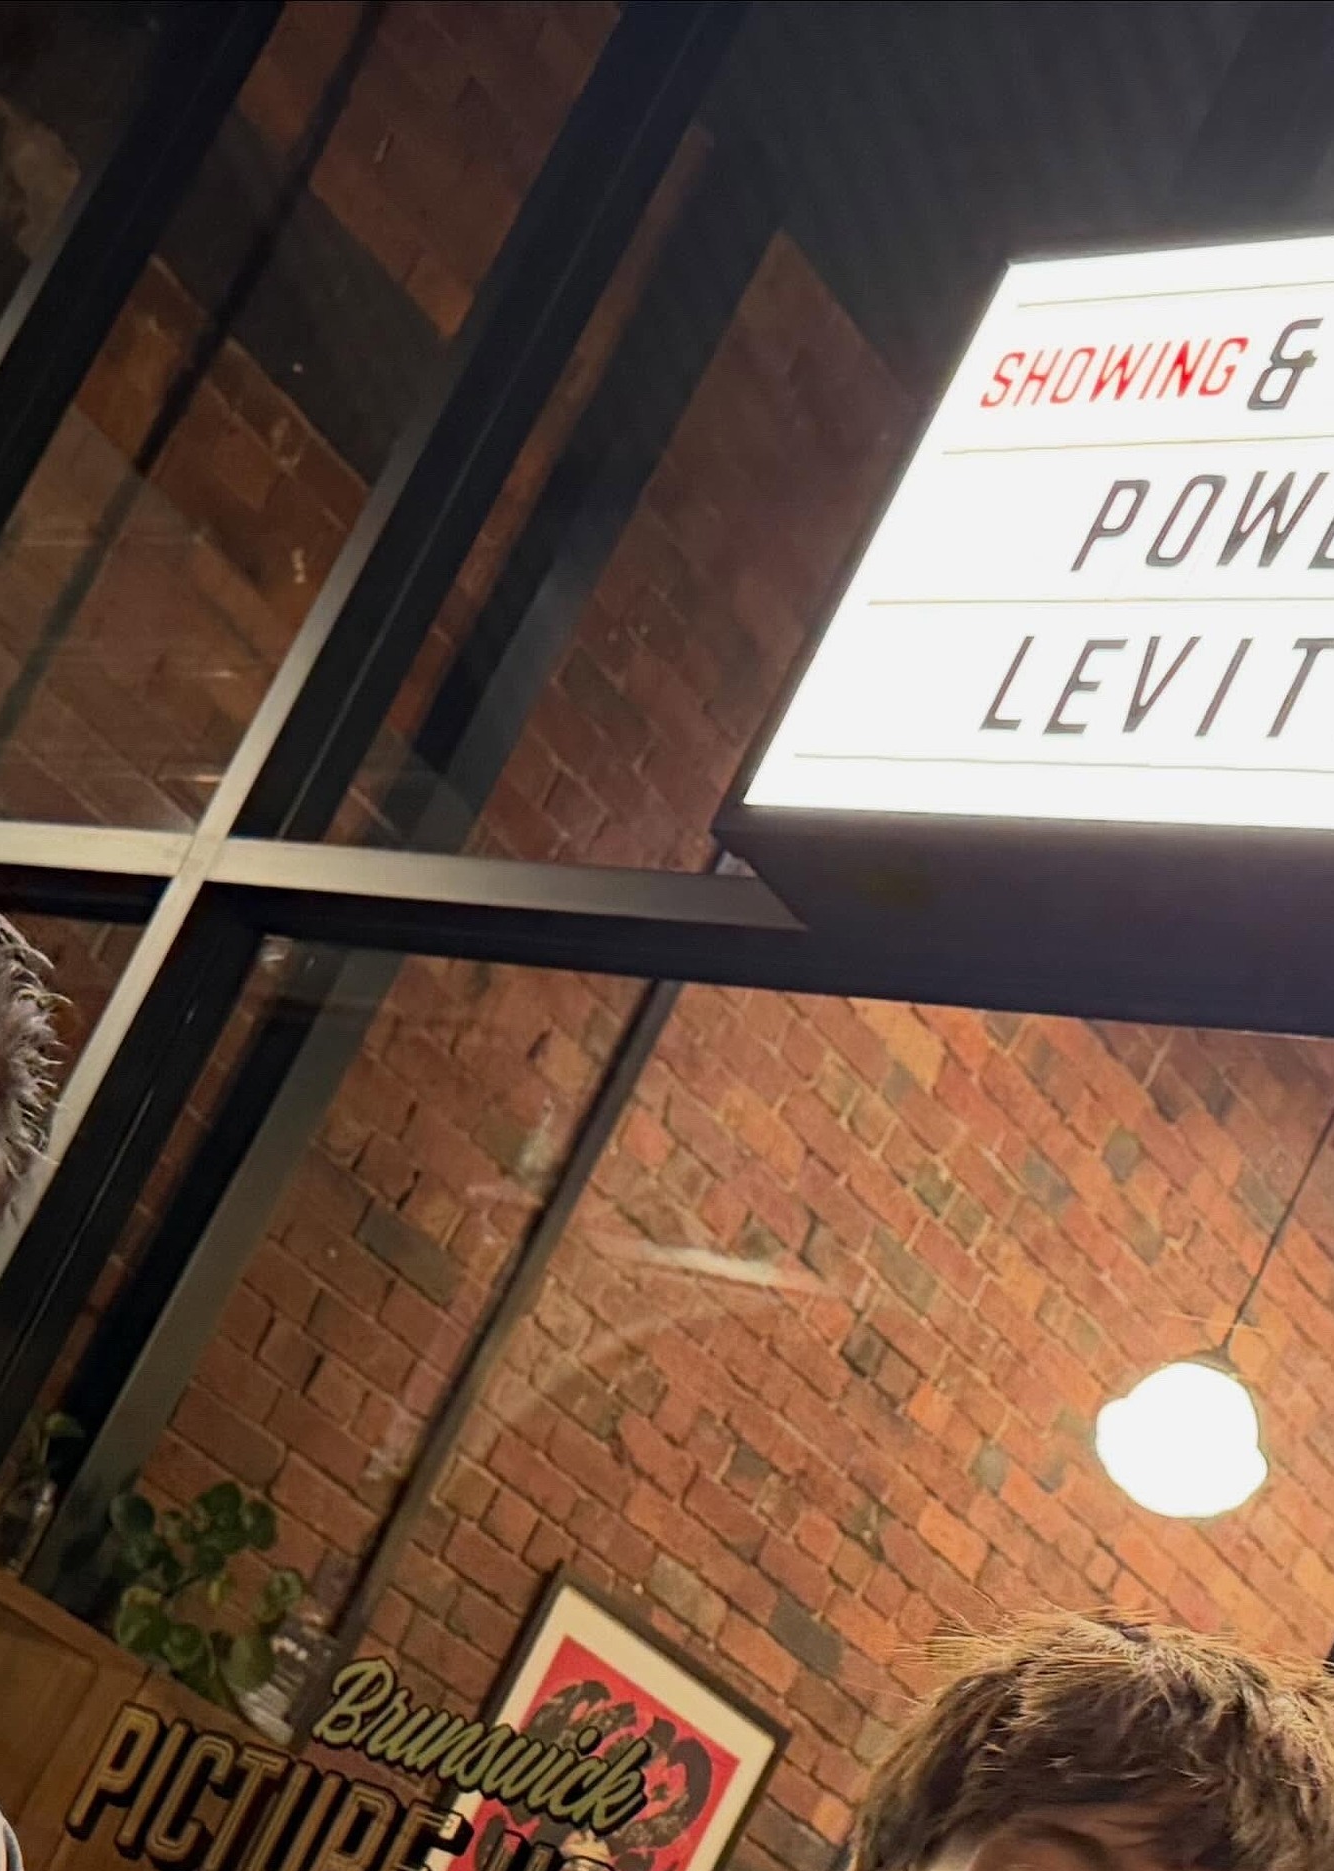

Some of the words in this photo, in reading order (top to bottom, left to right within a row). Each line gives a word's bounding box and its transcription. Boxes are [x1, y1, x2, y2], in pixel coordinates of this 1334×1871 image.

[979, 336, 1250, 409] SHOWING
[1244, 317, 1324, 412] &
[312, 1656, 653, 1835] Brunswick
